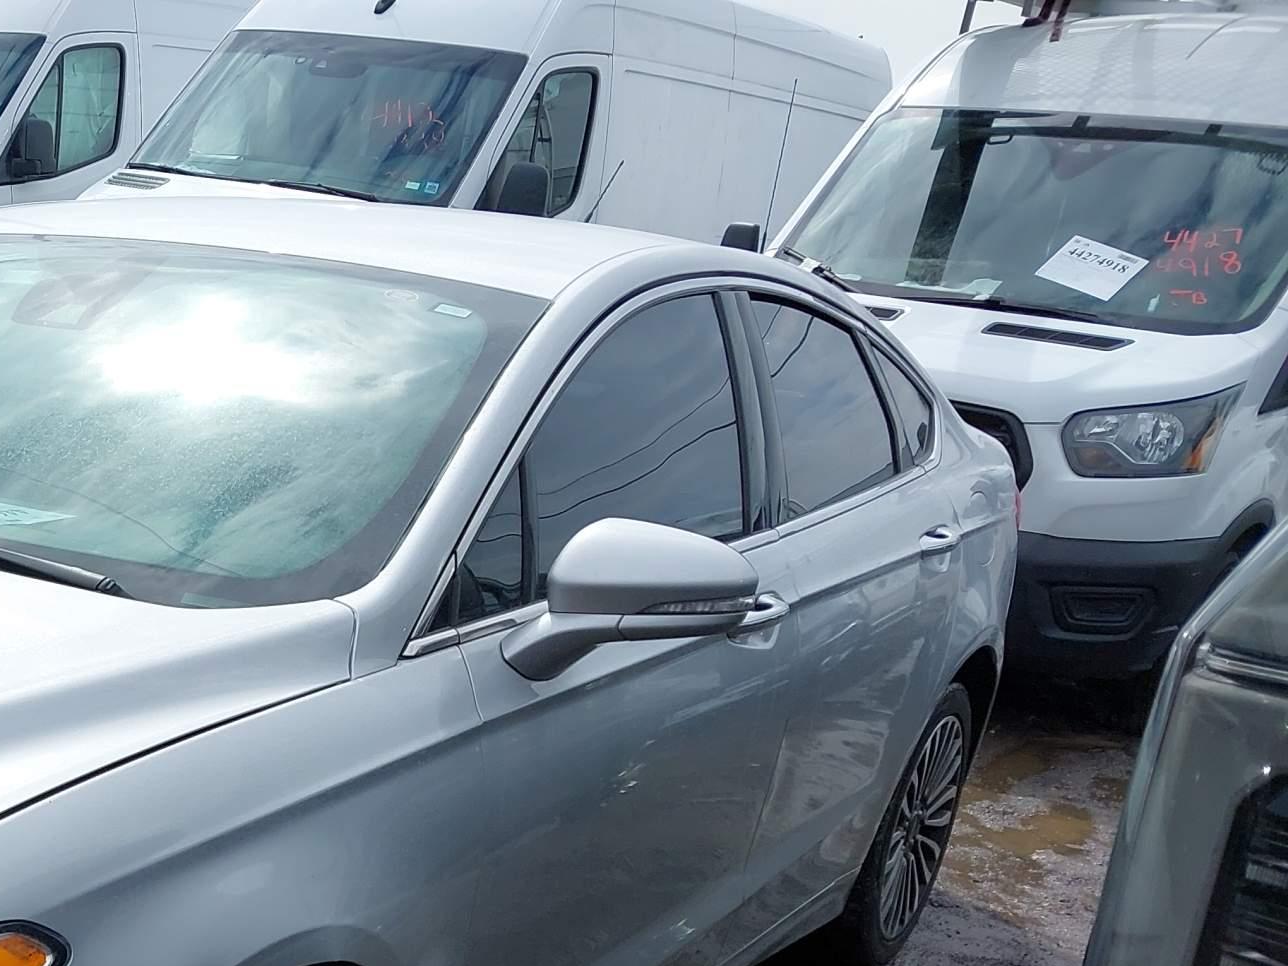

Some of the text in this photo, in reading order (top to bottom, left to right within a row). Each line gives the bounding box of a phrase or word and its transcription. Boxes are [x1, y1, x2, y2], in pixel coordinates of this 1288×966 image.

[1163, 227, 1244, 253] 4427
[1068, 246, 1130, 274] 44274918
[1156, 250, 1242, 277] 4918
